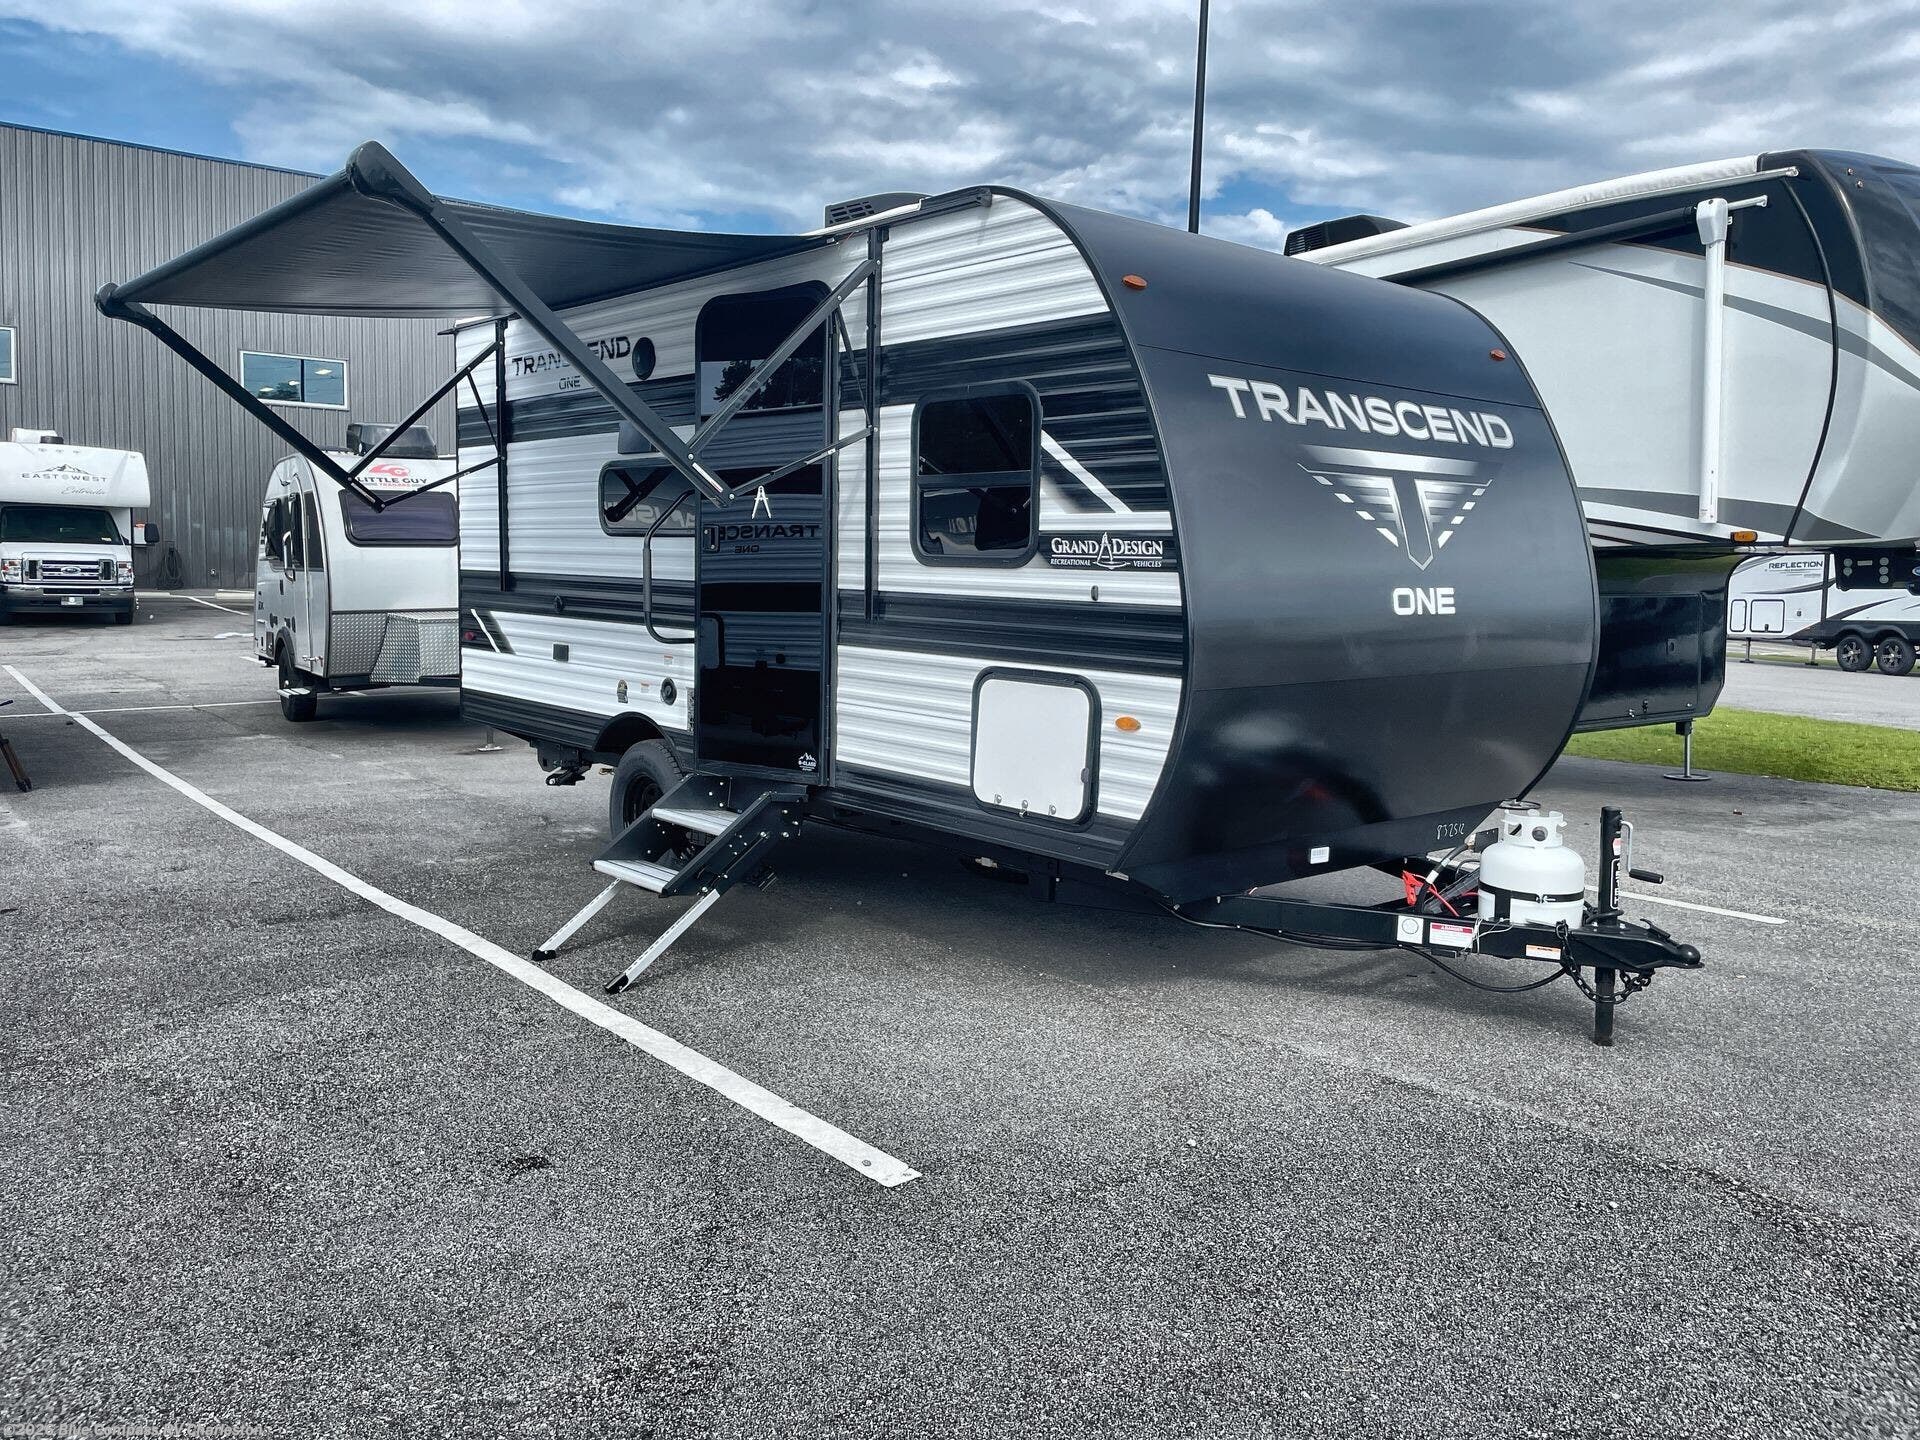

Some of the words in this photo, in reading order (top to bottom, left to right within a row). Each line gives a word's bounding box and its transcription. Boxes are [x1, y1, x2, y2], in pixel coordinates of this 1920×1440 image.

[511, 336, 631, 376] TRANEND
[558, 375, 581, 390] ONE
[1207, 373, 1516, 450] TRANSCEND
[21, 472, 59, 480] EAST
[71, 475, 107, 483] WEST
[357, 476, 399, 484] LITTLE
[1051, 538, 1099, 554] GRAND
[1111, 538, 1163, 555] DESIGN
[1133, 560, 1162, 568] VEHICLES
[1769, 561, 1823, 569] REFLECTION
[1392, 587, 1456, 616] ONE
